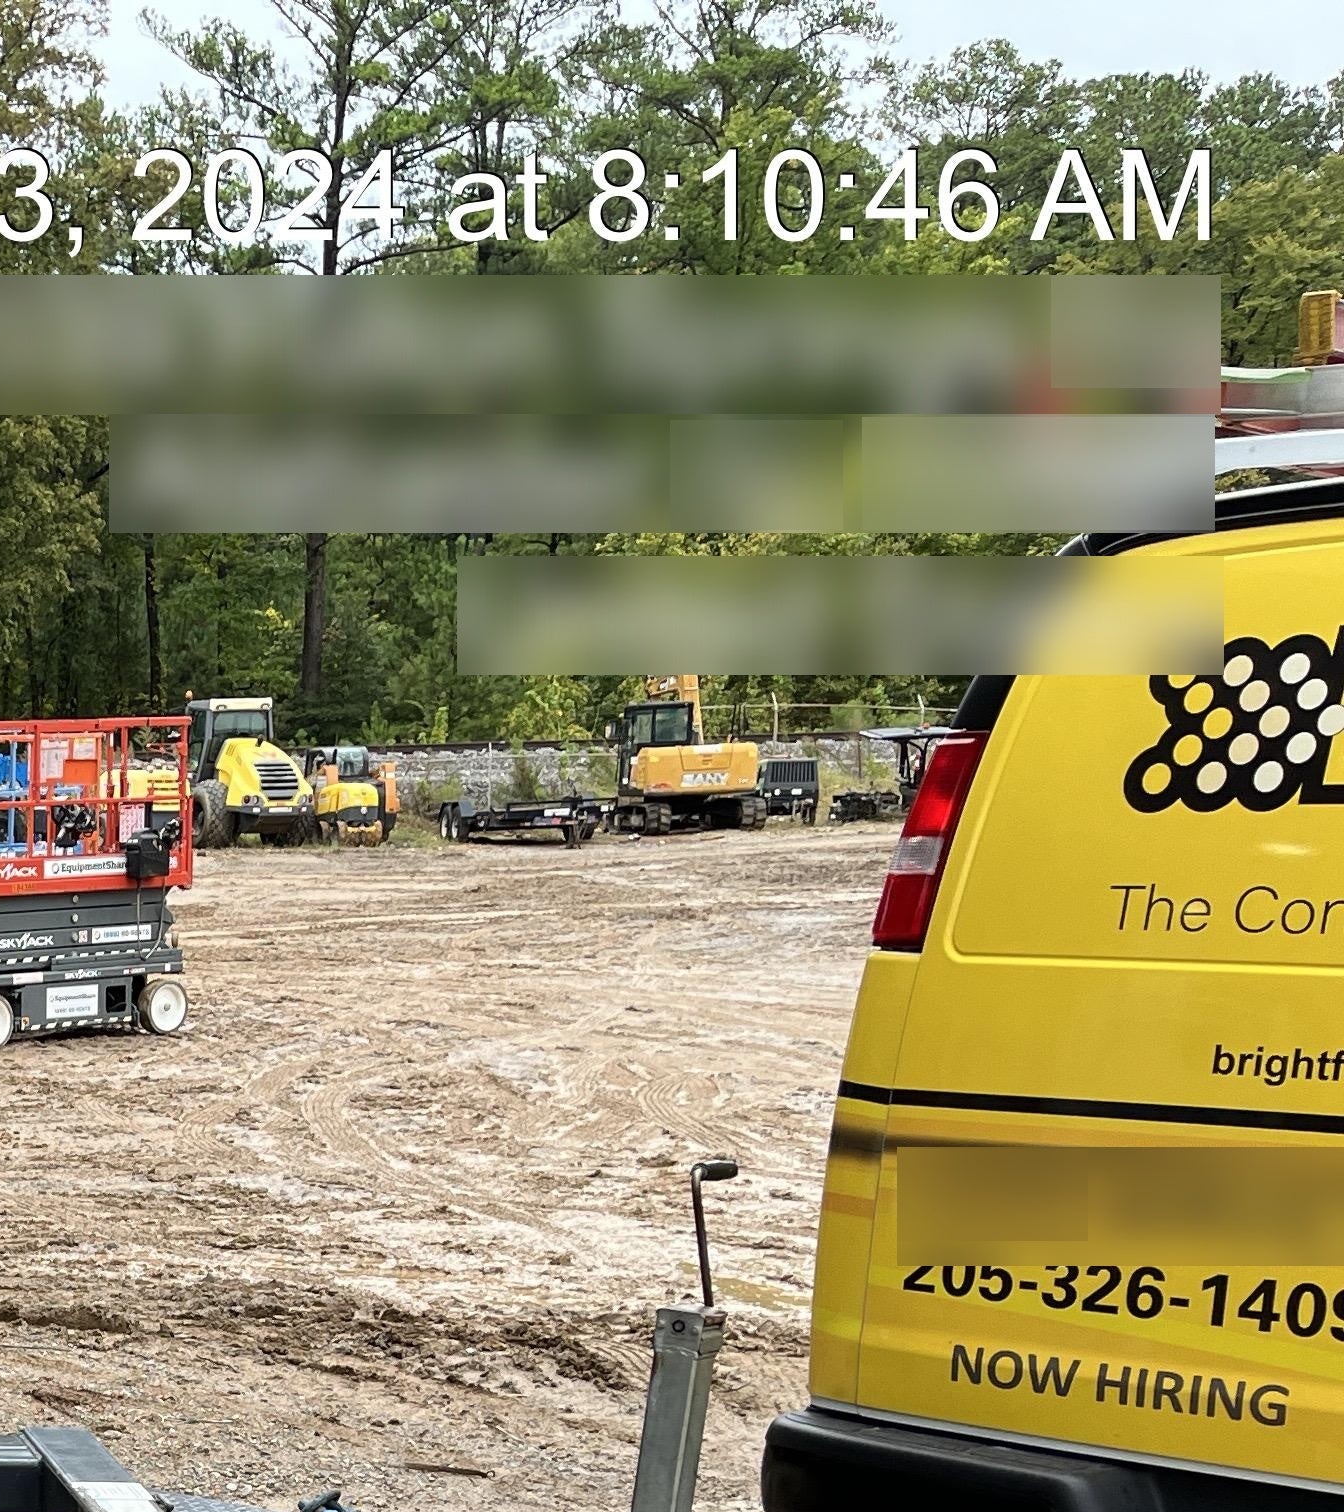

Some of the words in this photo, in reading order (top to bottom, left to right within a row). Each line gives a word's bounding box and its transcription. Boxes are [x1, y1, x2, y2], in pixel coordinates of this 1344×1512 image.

[60, 859, 127, 874] EquipmentShar
[1111, 883, 1212, 932] The
[951, 1344, 1081, 1398] NOW
[1095, 1363, 1291, 1427] HIRING
